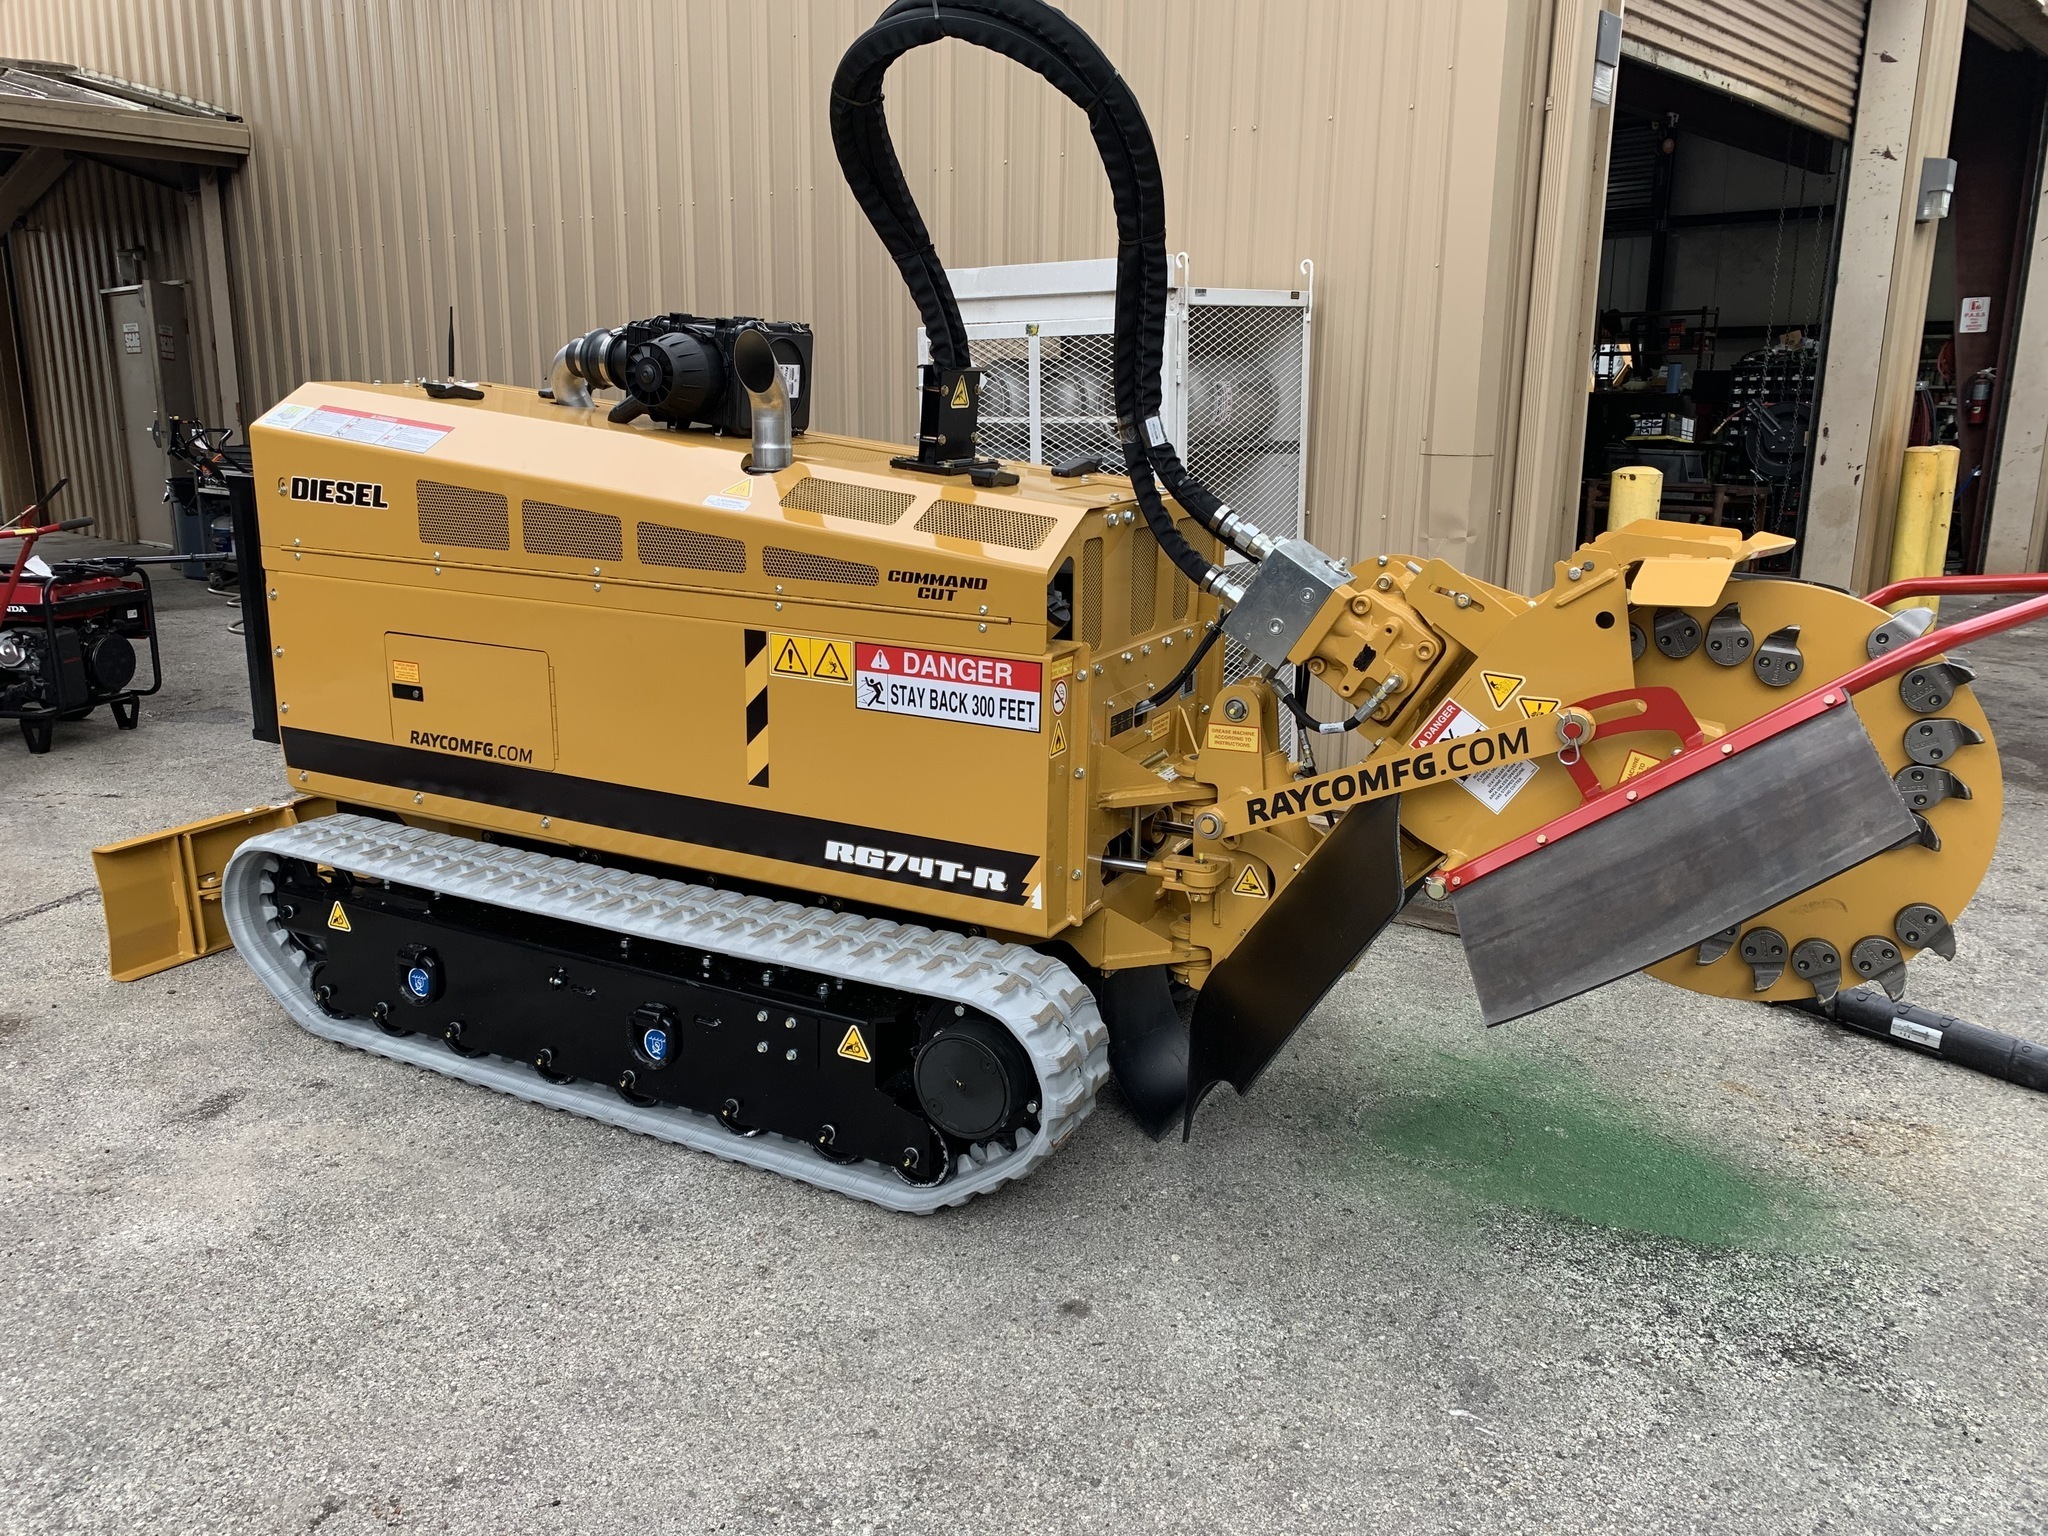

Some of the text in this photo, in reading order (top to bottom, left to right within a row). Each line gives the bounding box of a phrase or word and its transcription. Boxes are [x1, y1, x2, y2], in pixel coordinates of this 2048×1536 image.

[291, 476, 389, 509] DIESEL
[887, 569, 988, 591] COMMAND
[917, 586, 958, 602] CUT
[903, 651, 1013, 687] DANGER
[890, 683, 1035, 723] STAY BACK 300 FEET
[1424, 704, 1456, 740] DANGER
[410, 730, 533, 764] RAYCOMFG.COM
[1246, 727, 1529, 825] RAYCOMFG.COM
[1638, 762, 1646, 770] TO
[824, 839, 1008, 892] RG74T-R
